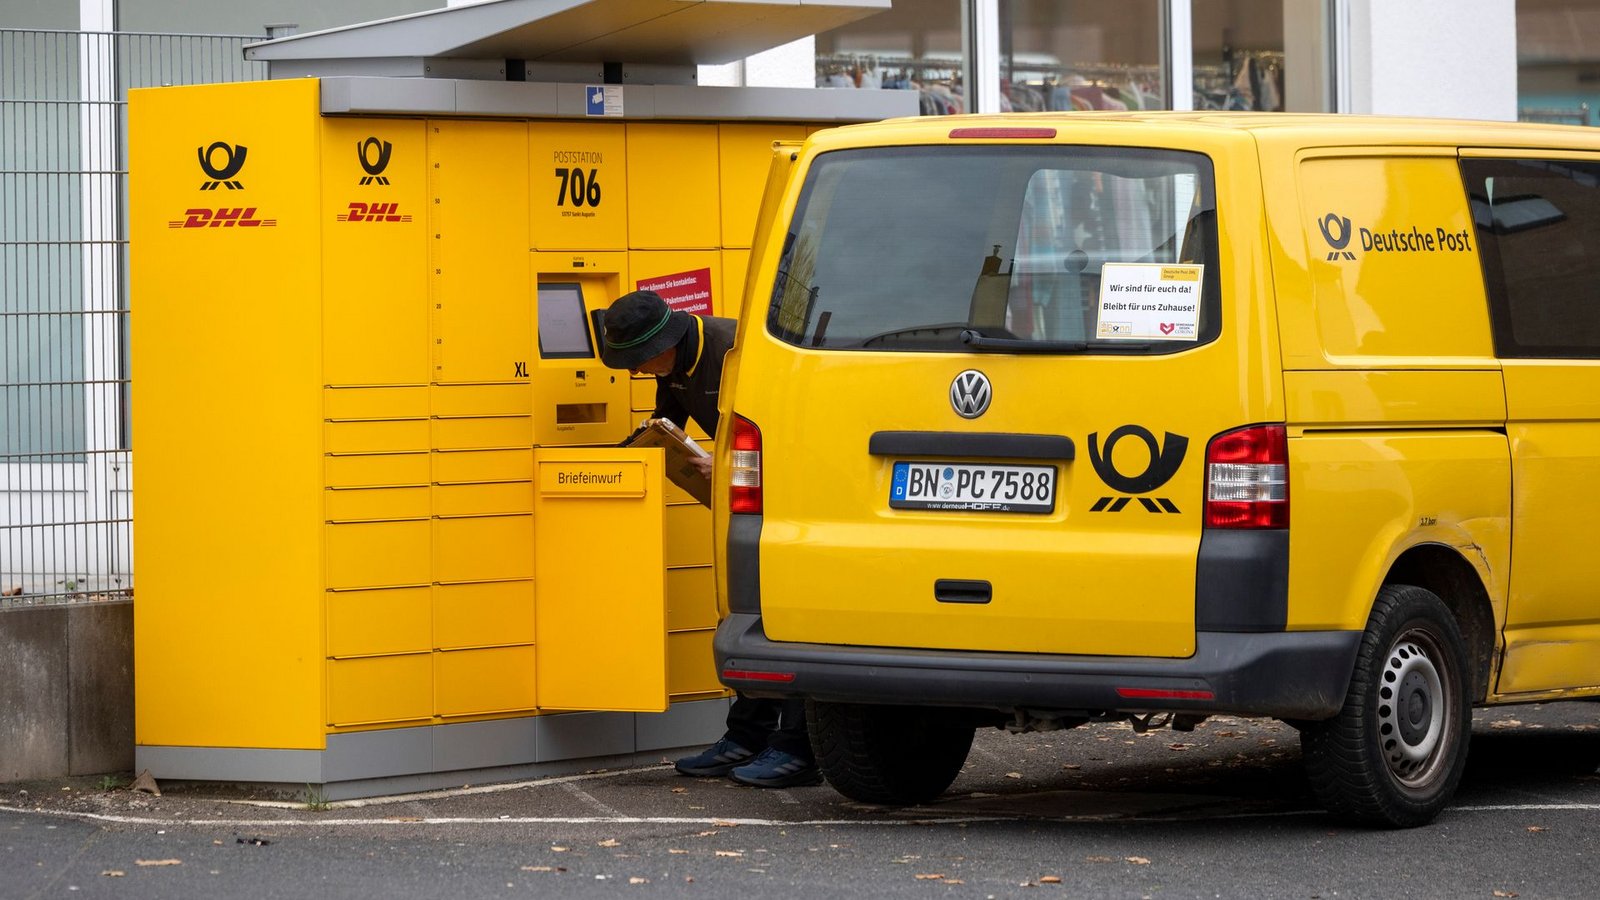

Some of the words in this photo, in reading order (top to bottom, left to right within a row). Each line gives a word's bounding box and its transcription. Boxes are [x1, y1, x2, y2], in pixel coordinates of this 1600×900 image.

[554, 151, 603, 163] POSTSTATION
[555, 167, 602, 207] 706
[182, 207, 262, 228] DHL
[346, 202, 402, 222] DHL
[1359, 226, 1435, 252] Deutsche
[1436, 227, 1472, 252] Post
[649, 281, 666, 291] können
[665, 280, 673, 288] Sie
[1109, 284, 1123, 292] Wir
[1125, 284, 1142, 292] sind
[1143, 284, 1156, 292] für
[1157, 285, 1177, 293] euch
[1178, 285, 1192, 293] da!
[694, 291, 709, 300] kaufen
[1103, 302, 1126, 311] Bleibt
[1128, 303, 1141, 311] für
[1157, 303, 1195, 312] Zuhause!
[514, 362, 530, 377] XL
[950, 370, 991, 418] VW
[557, 471, 623, 484] Briefeinwurf
[908, 467, 940, 497] BN
[956, 469, 985, 499] PC
[990, 470, 1050, 501] 7588
[896, 486, 902, 495] D
